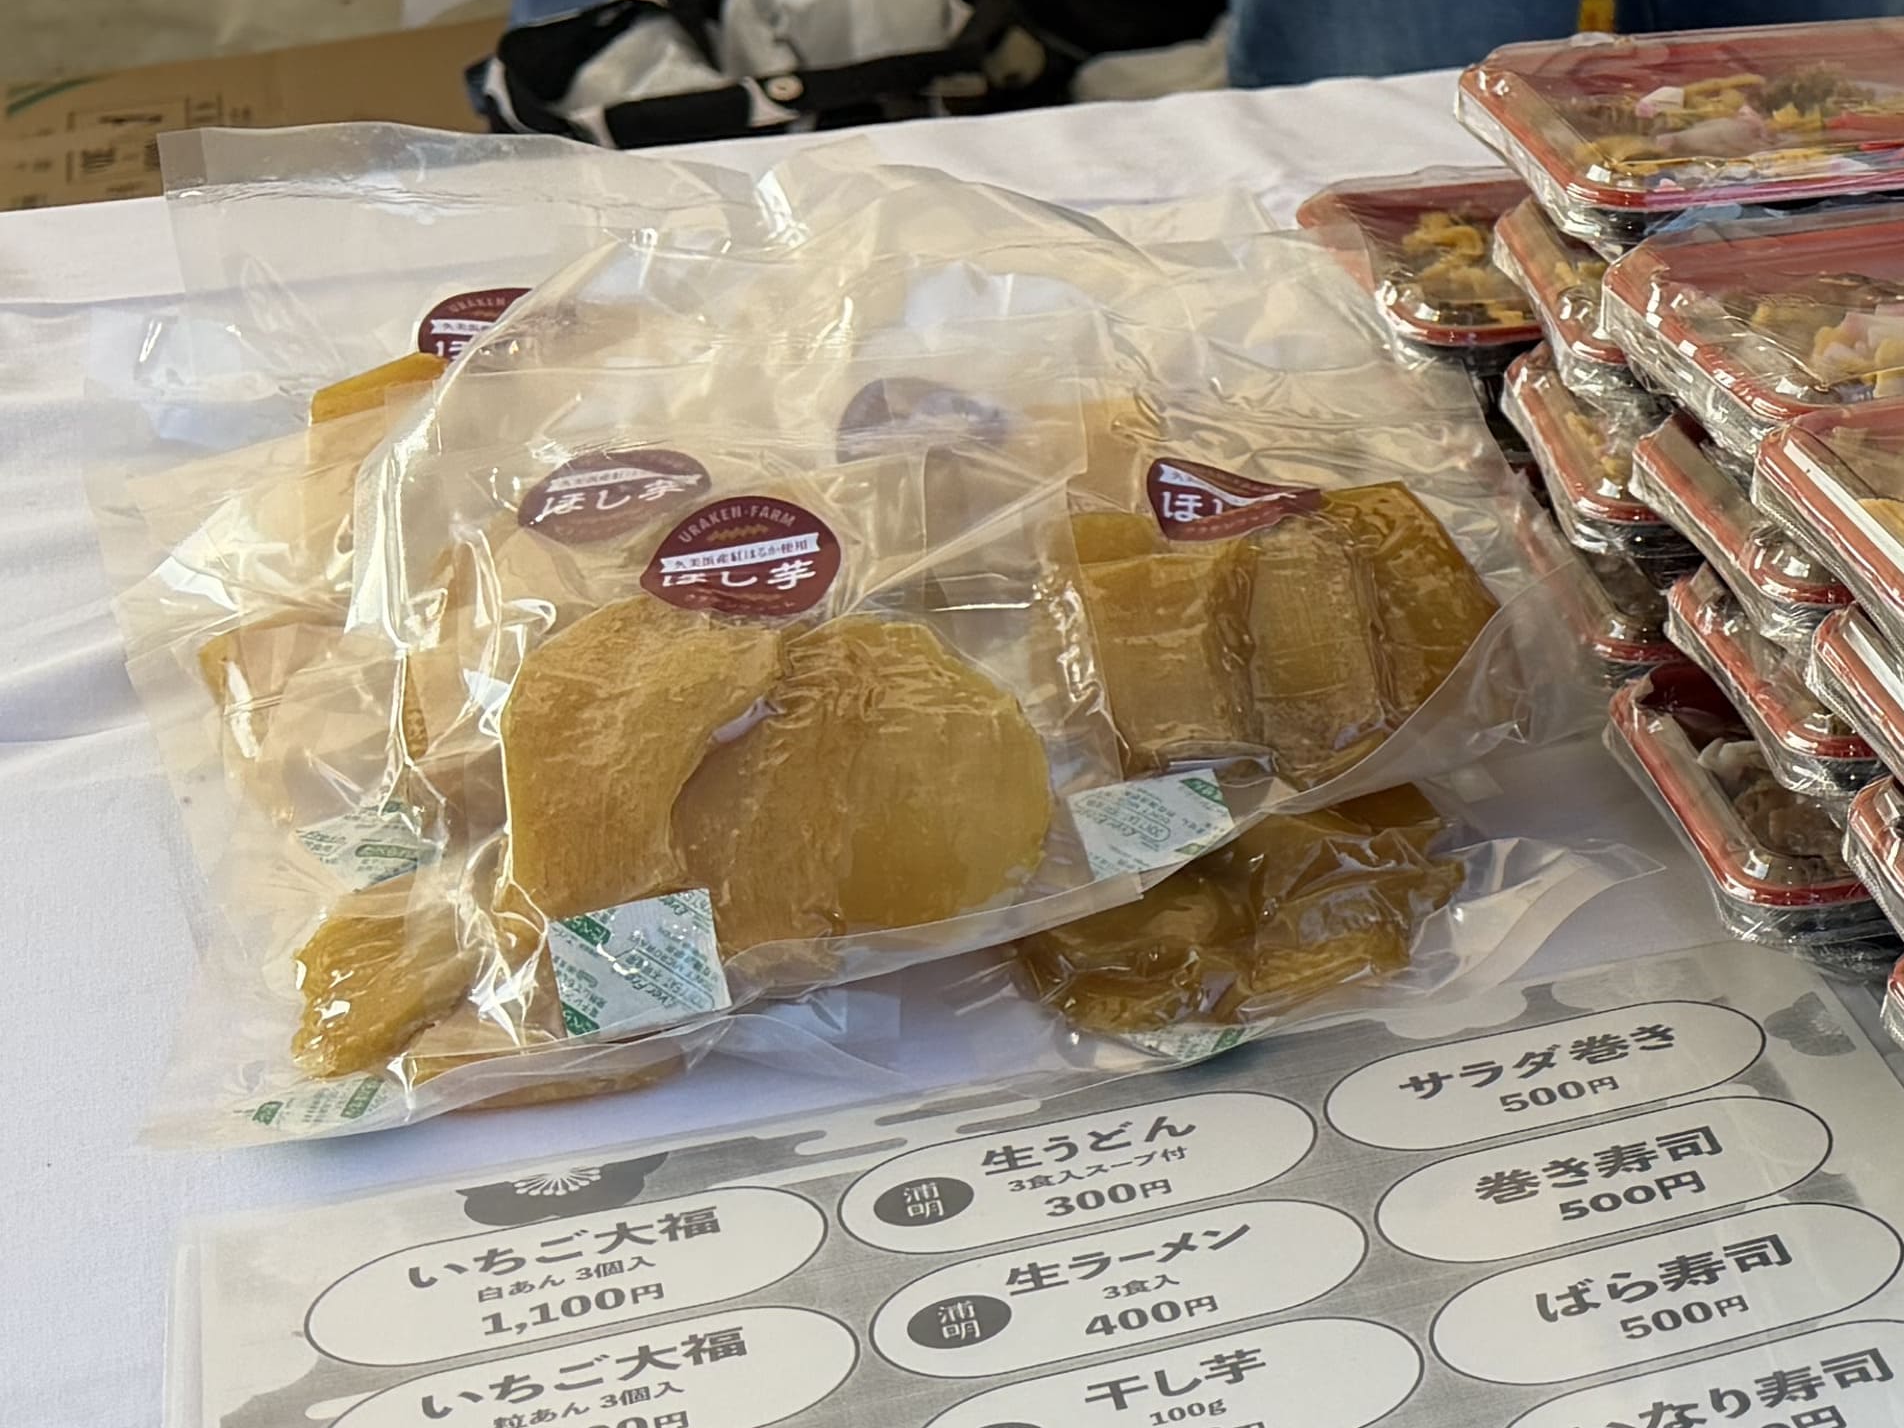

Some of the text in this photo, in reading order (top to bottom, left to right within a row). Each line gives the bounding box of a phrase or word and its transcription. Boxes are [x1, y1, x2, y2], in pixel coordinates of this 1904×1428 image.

[1398, 1023, 1675, 1100] サラダ巻き
[1499, 1075, 1620, 1113] 500円
[980, 1115, 1197, 1176] 生うどん
[1007, 1145, 1188, 1193] 3食入スープ付
[1475, 1125, 1723, 1205] 巻き寿司
[1044, 1178, 1173, 1217] 300円
[1558, 1170, 1706, 1221] 500円
[408, 1205, 721, 1289] いちご大福
[1005, 1223, 1251, 1297] 生ラーメン
[477, 1255, 657, 1304] 白あん 3個入
[1102, 1273, 1181, 1300] 3食入
[1535, 1233, 1793, 1323] ばら寿司
[481, 1282, 665, 1336] 1,100円
[1084, 1295, 1219, 1336] 400円
[1619, 1294, 1750, 1340] 500円
[421, 1325, 748, 1420] いちご大福
[599, 1381, 685, 1409] 3個入
[1084, 1348, 1267, 1411] 干し芋
[1149, 1398, 1227, 1427] 100g
